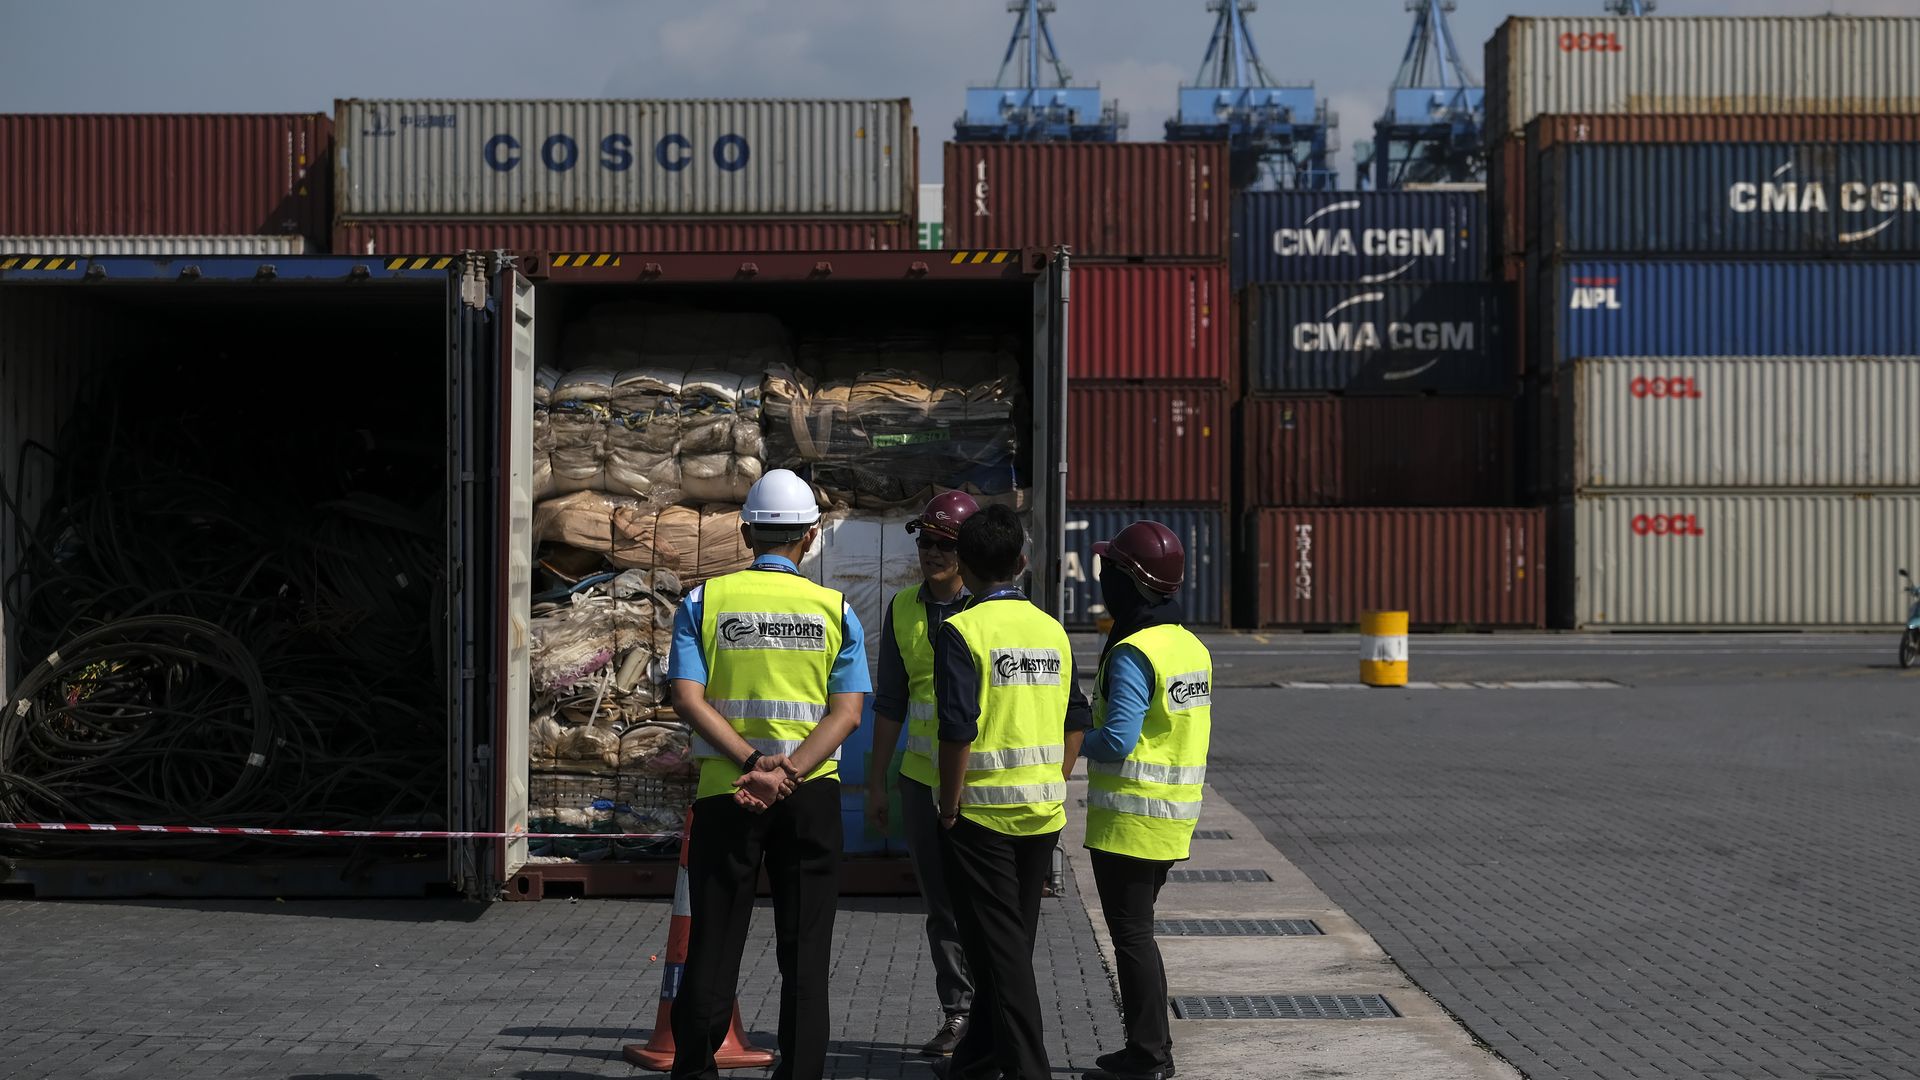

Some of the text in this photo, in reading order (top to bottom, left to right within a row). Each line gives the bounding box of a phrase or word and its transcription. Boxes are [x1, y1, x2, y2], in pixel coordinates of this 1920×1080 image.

[1559, 32, 1623, 53] OOCL
[484, 132, 751, 174] COSCO
[974, 159, 990, 217] tex
[1729, 182, 1829, 213] CMA
[1273, 228, 1356, 256] CMA
[1363, 228, 1445, 256] CGM
[1570, 287, 1621, 310] APL
[1293, 322, 1380, 351] CMA
[1386, 322, 1474, 351] CGM
[1630, 376, 1702, 399] OOCL
[1631, 513, 1704, 537] OOCL
[758, 622, 824, 637] WESTPORTS
